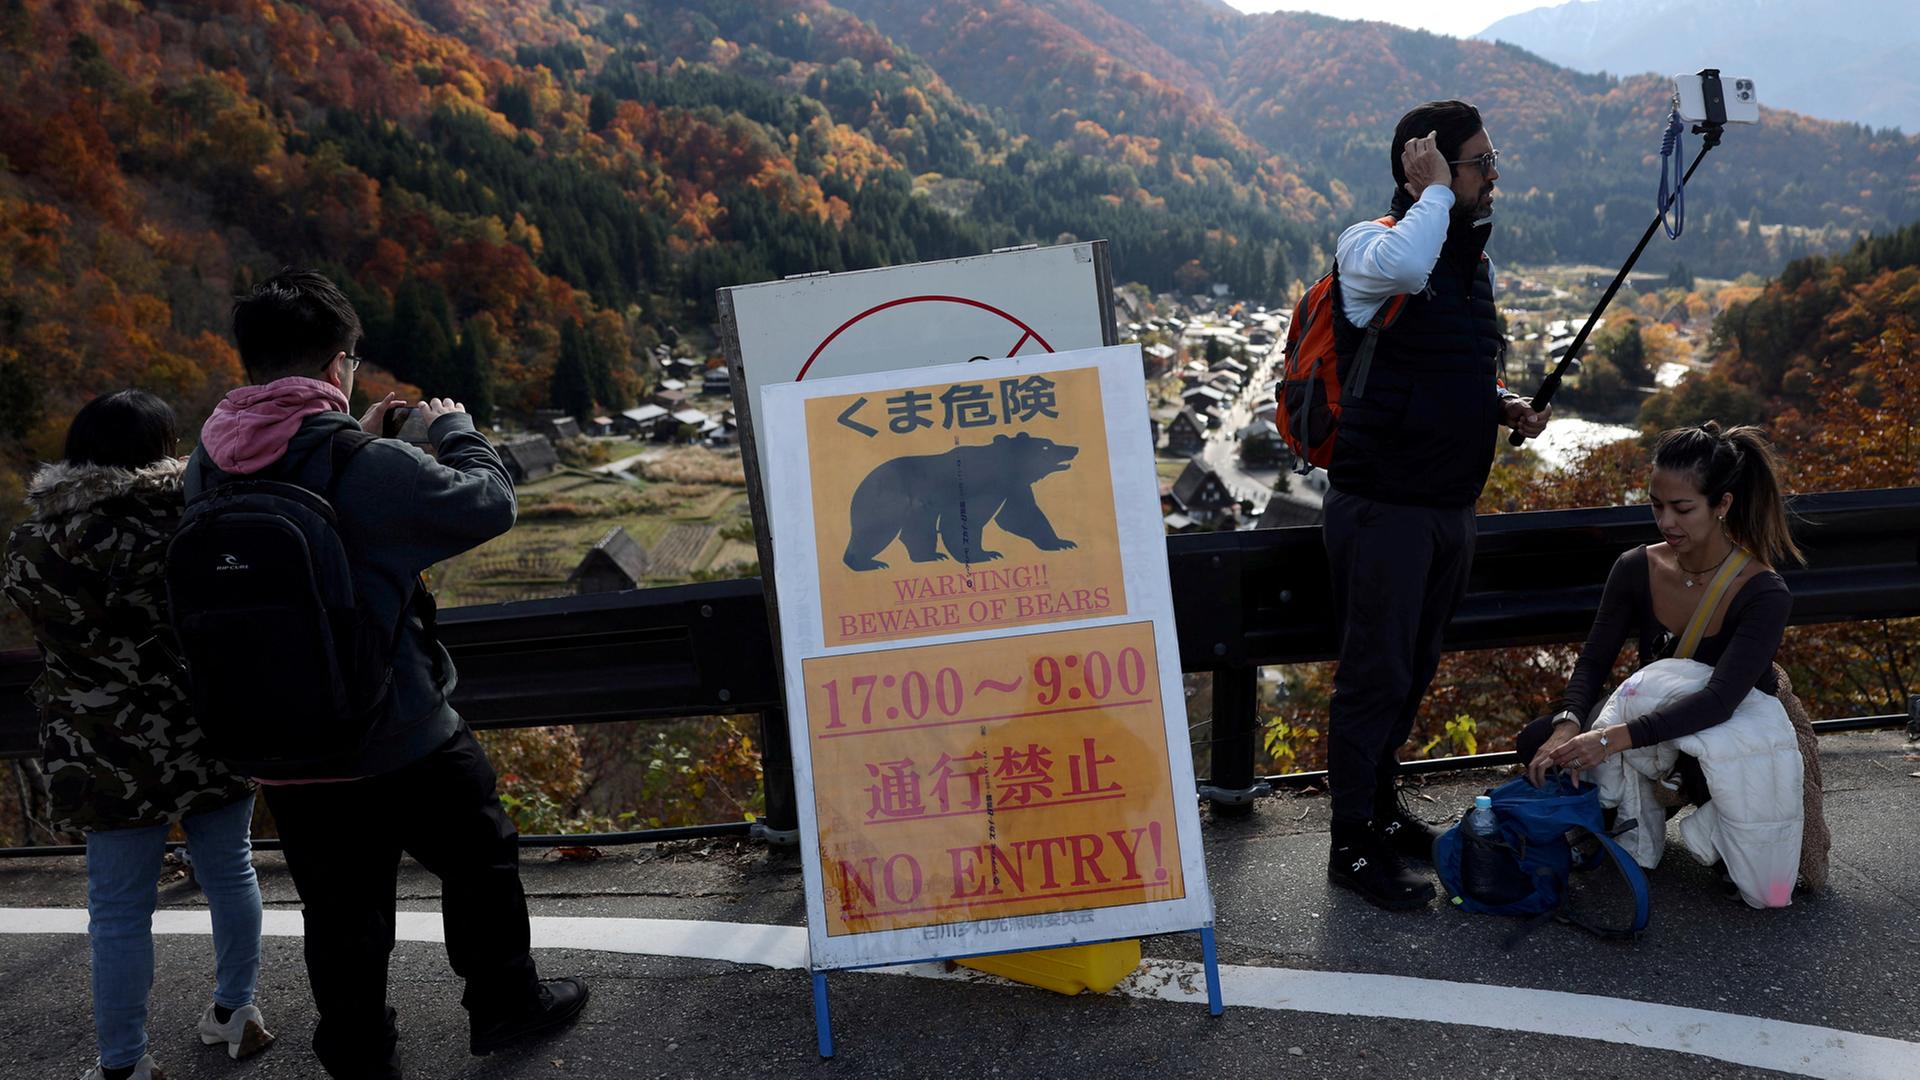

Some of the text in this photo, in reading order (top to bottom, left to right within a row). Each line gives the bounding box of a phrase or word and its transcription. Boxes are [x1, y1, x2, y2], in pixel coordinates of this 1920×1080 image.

[837, 375, 1059, 438] くま危険
[839, 587, 1111, 637] BEWARE OF BEARS
[893, 564, 1049, 601] WARNING!!
[864, 738, 1123, 820] 通行禁止
[839, 852, 923, 912] NO
[946, 821, 1168, 899] ENTRY!
